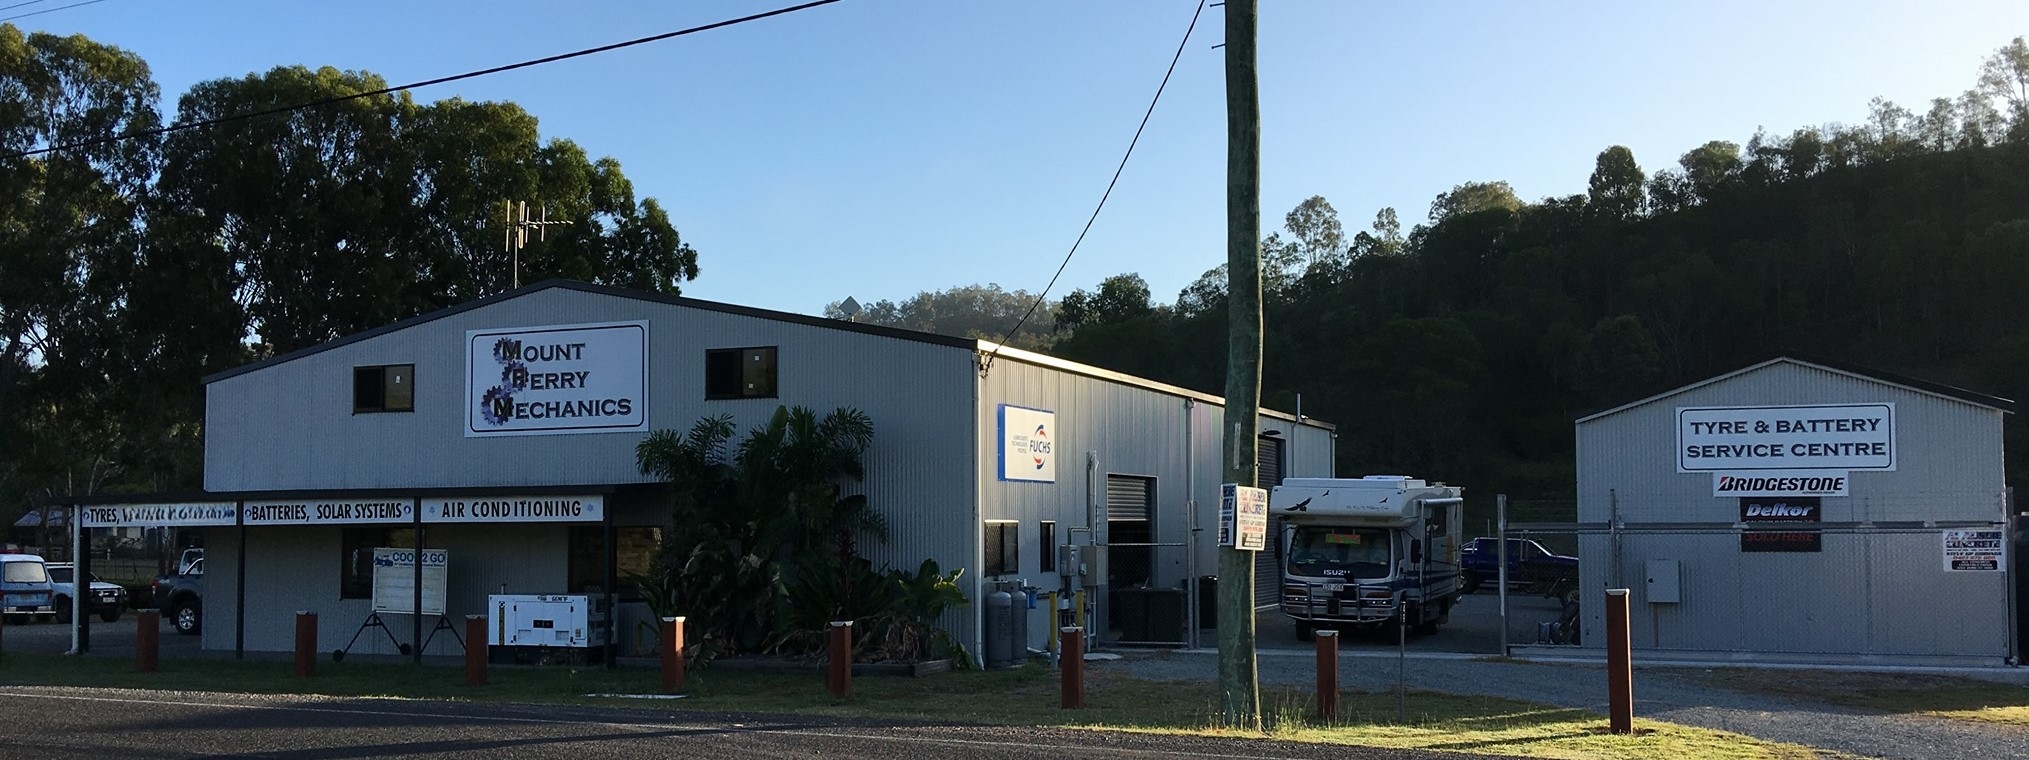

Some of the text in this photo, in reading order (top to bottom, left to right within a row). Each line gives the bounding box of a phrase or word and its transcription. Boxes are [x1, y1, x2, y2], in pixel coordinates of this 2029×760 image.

[502, 340, 586, 362] MOUNT
[493, 398, 632, 419] MECHANICS
[1690, 418, 1881, 435] TYRE & BATTERY
[1029, 440, 1051, 454] FUCHS
[1687, 442, 1887, 458] SERVICE CENTRE
[1718, 476, 1845, 491] BRIDGESTONE
[90, 508, 120, 525] TYRES,
[252, 505, 310, 522] BATTERIES,
[317, 504, 351, 519] SOLAR
[355, 503, 402, 519] SYSTEMS
[442, 500, 581, 518] AIR CONDITIONING
[1746, 503, 1813, 517] Delkor
[392, 552, 445, 563] COO 2 GO
